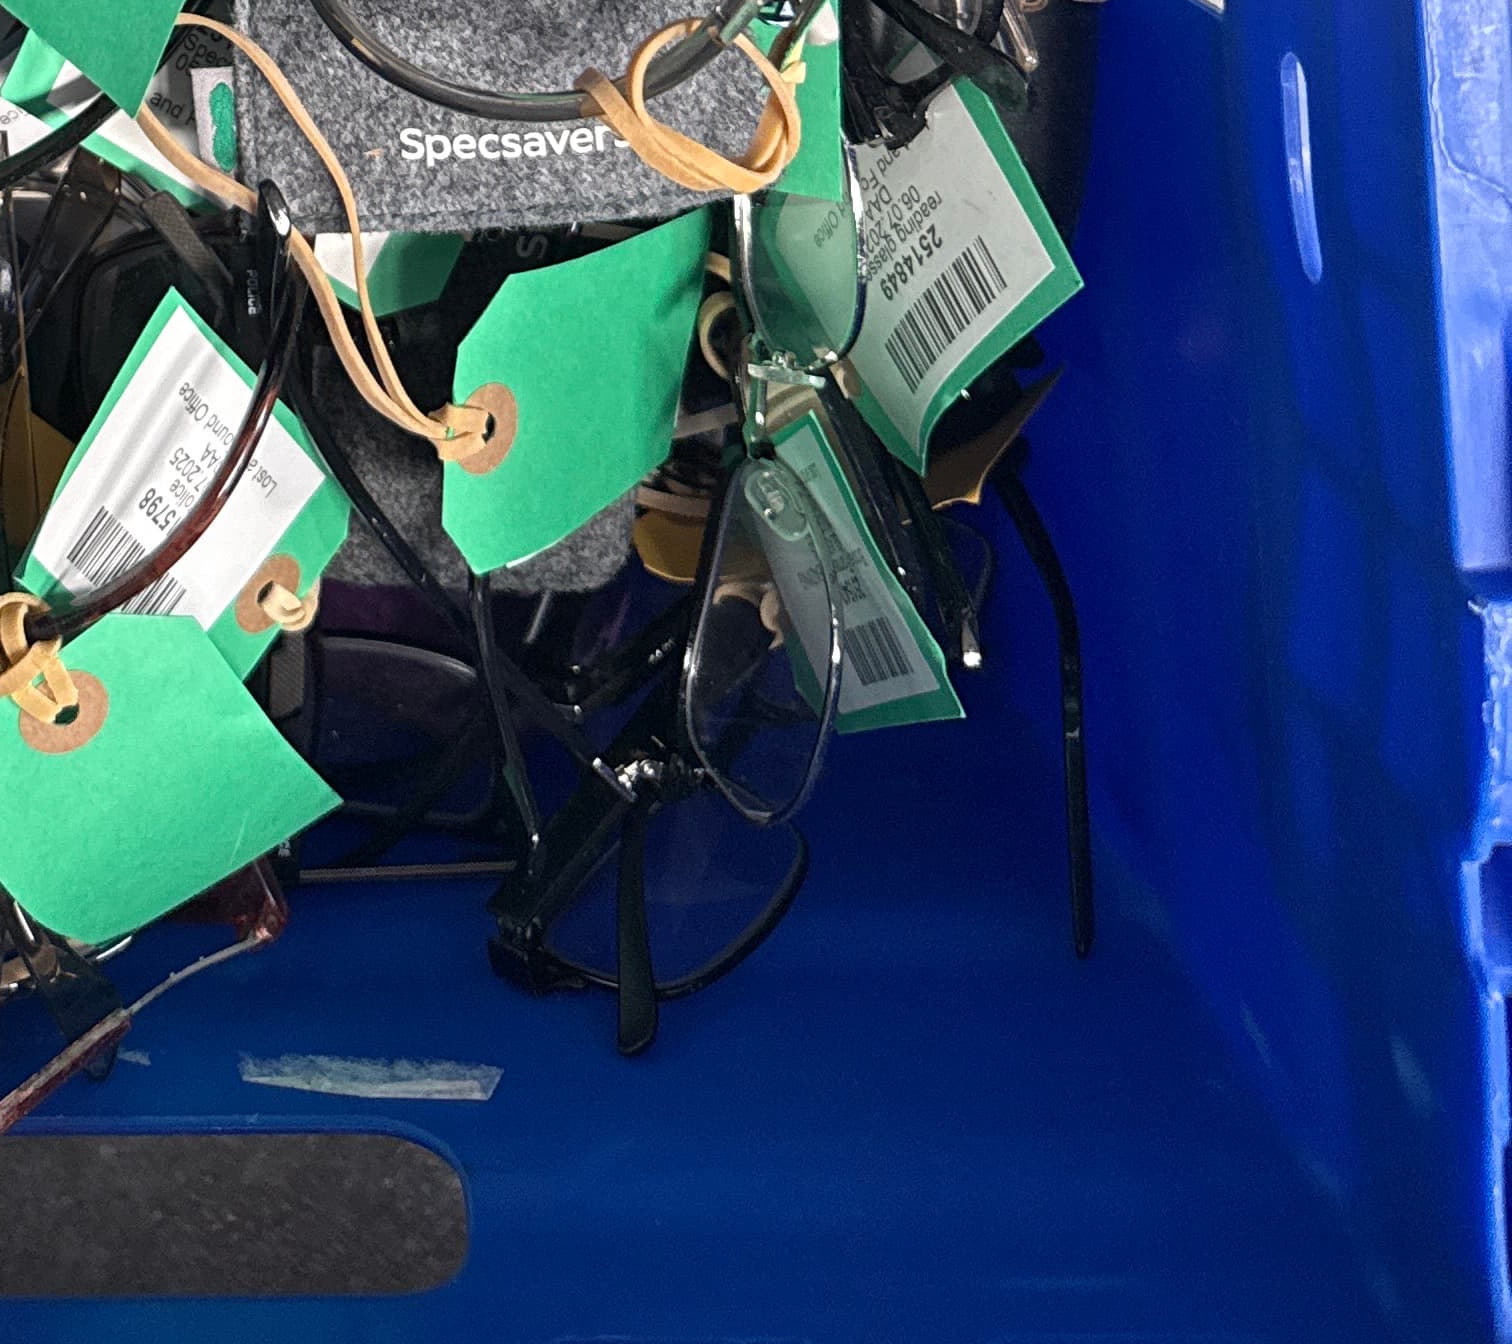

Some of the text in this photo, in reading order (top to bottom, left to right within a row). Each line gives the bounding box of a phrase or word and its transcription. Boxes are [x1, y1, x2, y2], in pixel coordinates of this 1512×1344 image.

[863, 183, 892, 221] DAA
[894, 190, 942, 243] reading
[813, 208, 840, 248] Office
[879, 223, 942, 300] 2514849
[178, 381, 208, 421] Office
[203, 413, 236, 445] ound
[168, 478, 194, 507] olice
[251, 465, 277, 498] Lost
